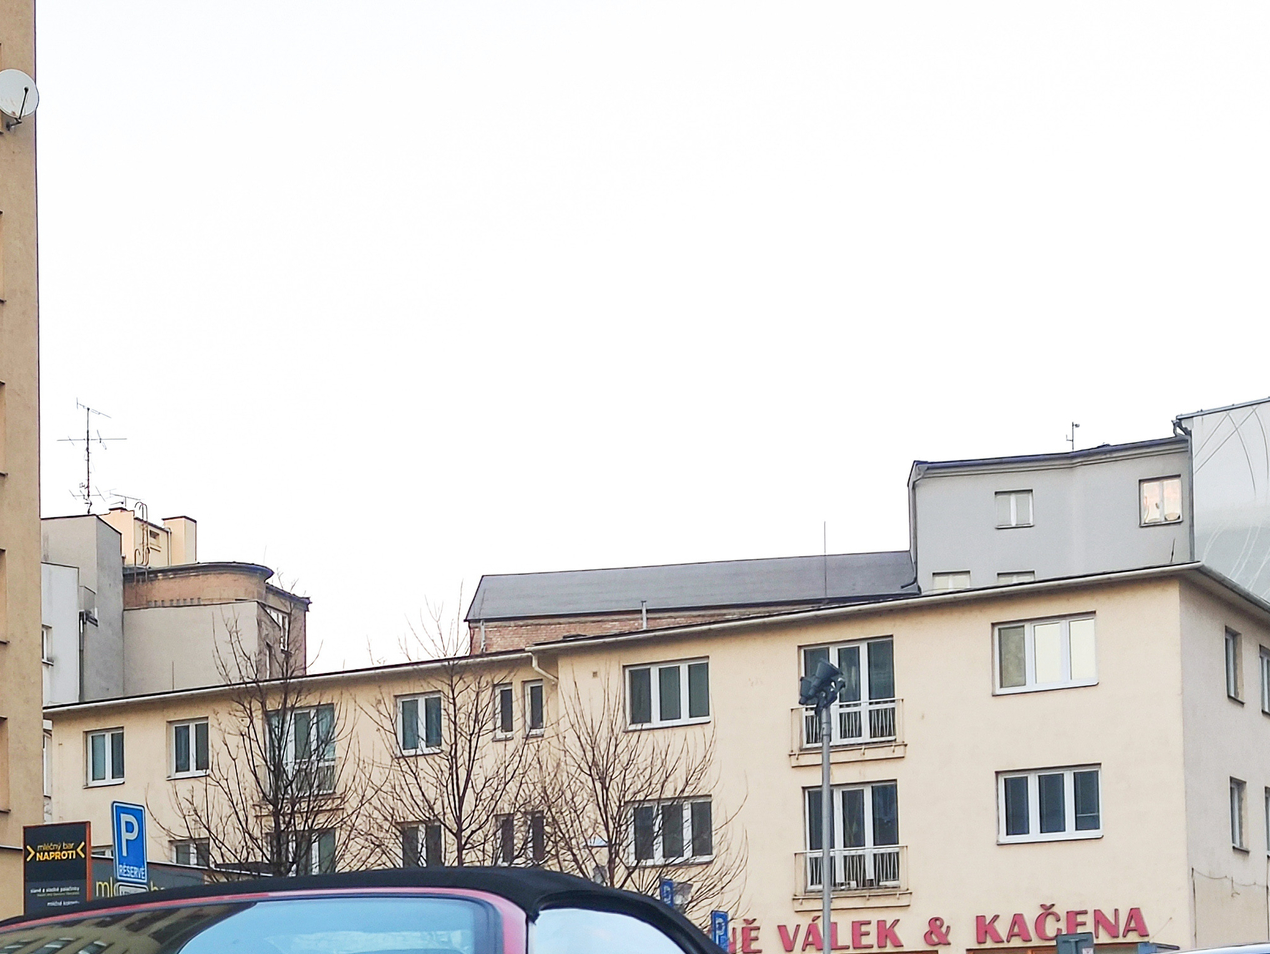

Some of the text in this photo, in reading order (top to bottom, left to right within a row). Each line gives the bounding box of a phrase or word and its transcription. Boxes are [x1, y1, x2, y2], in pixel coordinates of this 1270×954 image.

[120, 813, 139, 857] P
[63, 841, 75, 850] bar
[36, 849, 76, 862] NAPROTI
[118, 863, 146, 880] RÉSERVÉ
[776, 915, 904, 952] VÁLEK
[923, 915, 951, 946] &
[975, 903, 1151, 945] KAČENA
